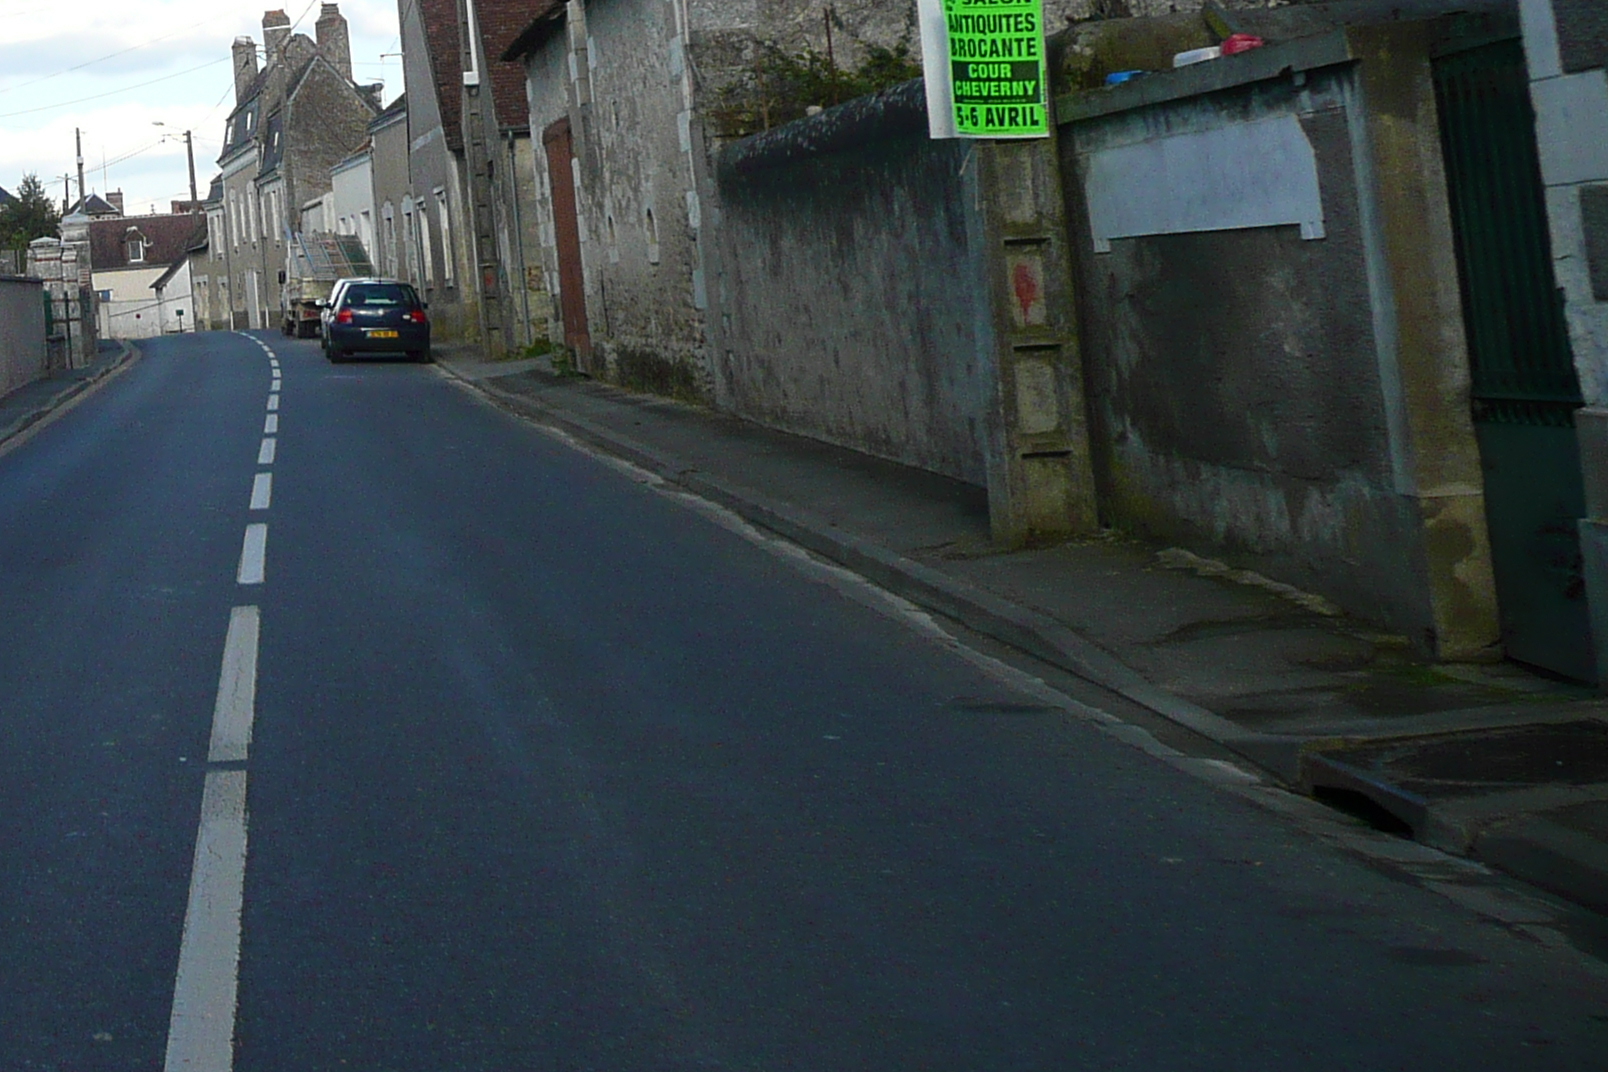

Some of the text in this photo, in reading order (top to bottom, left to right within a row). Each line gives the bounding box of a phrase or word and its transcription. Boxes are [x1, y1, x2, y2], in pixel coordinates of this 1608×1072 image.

[948, 13, 1036, 35] ANTIQUITES
[951, 37, 1037, 58] BROCANTE
[968, 63, 1012, 78] COUR
[954, 80, 1037, 97] CHEVERNY
[985, 106, 1040, 127] AVRIL
